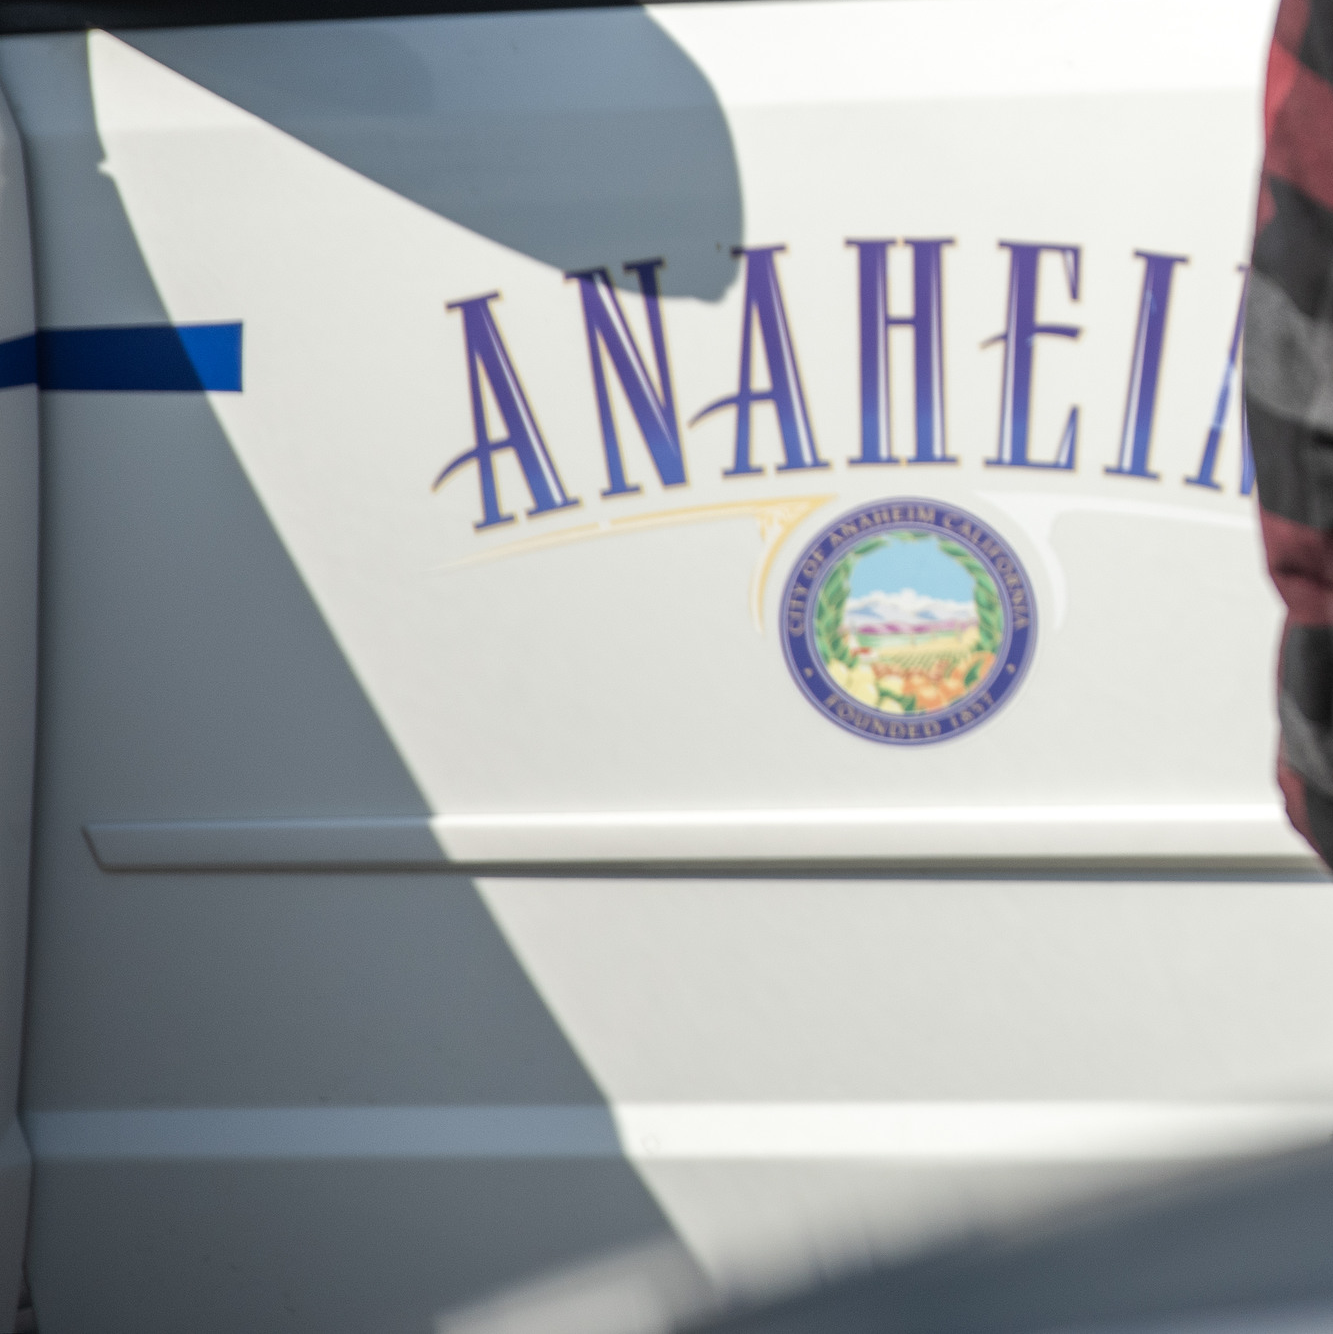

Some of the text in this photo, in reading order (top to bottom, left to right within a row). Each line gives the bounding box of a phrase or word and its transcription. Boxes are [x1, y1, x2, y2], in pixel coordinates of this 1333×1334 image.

[788, 505, 1029, 636] CITY OF ANAHEIM CALIFORNIA
[824, 692, 942, 739] FOUNDED
